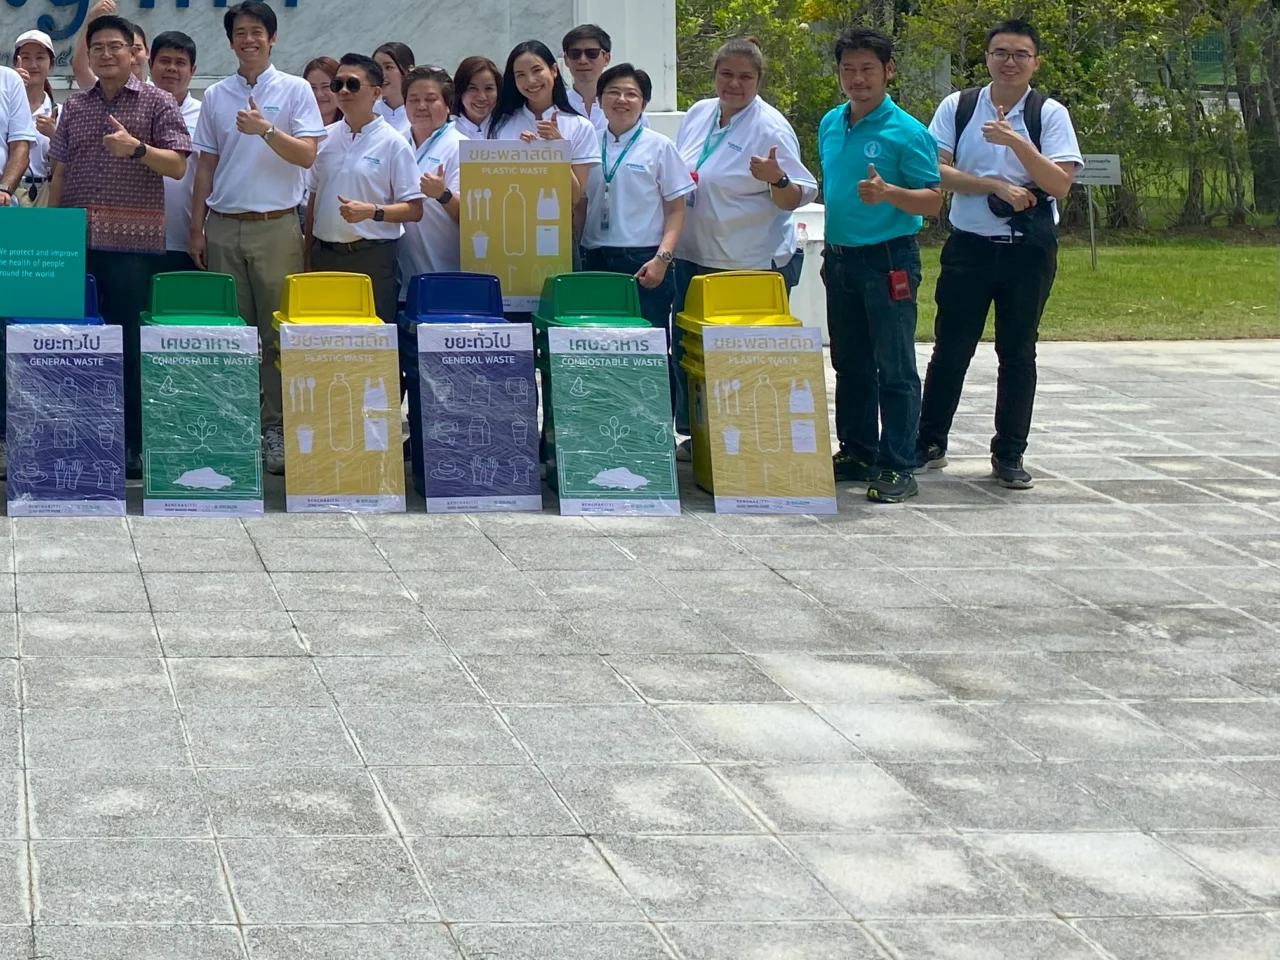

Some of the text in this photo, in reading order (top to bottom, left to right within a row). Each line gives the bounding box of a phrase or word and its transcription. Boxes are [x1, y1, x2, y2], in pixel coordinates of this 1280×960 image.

[469, 147, 563, 160] ขยะพลาสติก
[482, 167, 548, 175] PLASTIC WASTE
[51, 249, 79, 258] improve
[33, 259, 40, 267] of
[42, 260, 65, 268] people
[33, 334, 100, 350] ขยะทวไป
[161, 338, 240, 350] เศษอาหาร
[30, 358, 104, 366] GENERAL WASTE
[152, 356, 219, 365] COMPOSTABLE
[304, 354, 374, 362] PLASTIC WASTE
[442, 356, 516, 365] GENERAL WASTE
[729, 356, 798, 365] PLASTIC WASTE
